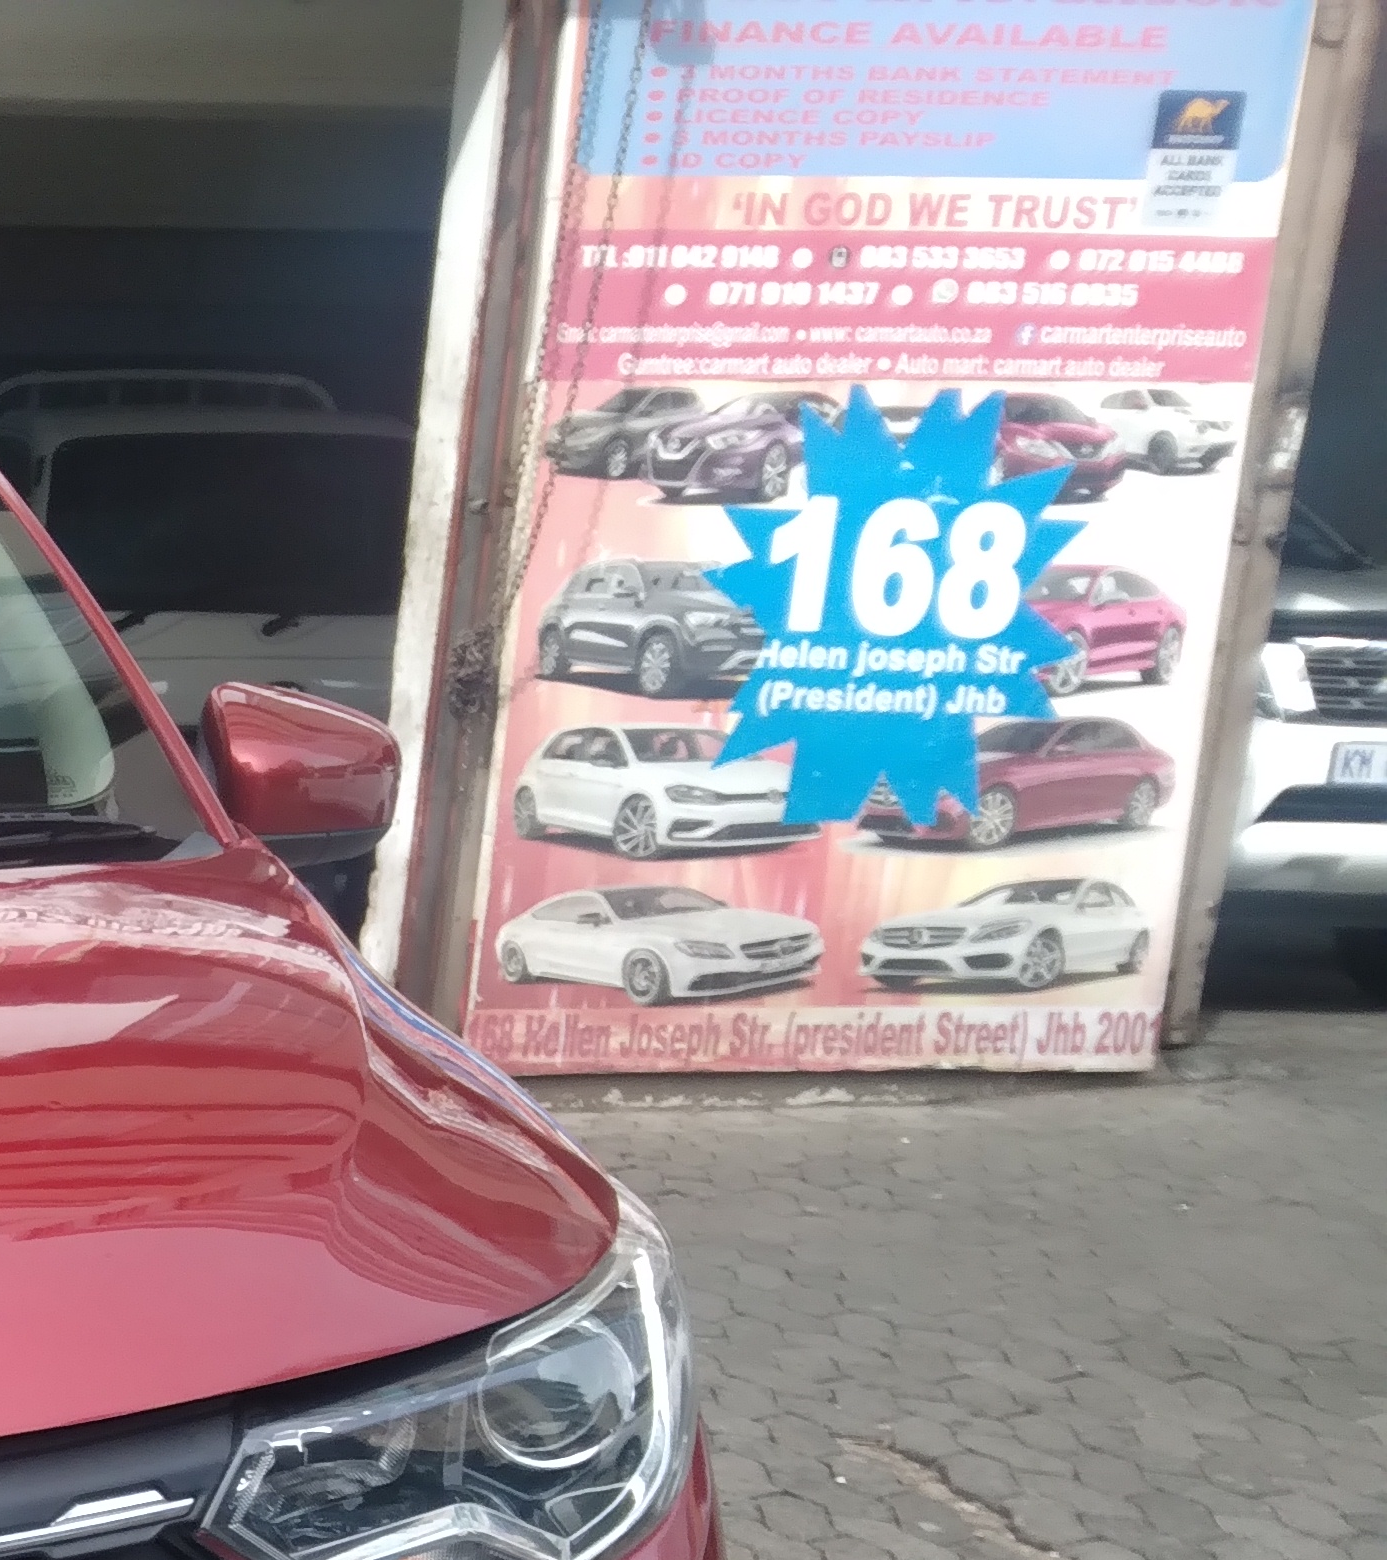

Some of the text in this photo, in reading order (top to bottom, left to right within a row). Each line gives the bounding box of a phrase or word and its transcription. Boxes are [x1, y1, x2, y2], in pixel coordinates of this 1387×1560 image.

[649, 19, 1170, 51] FINANCE AVAILABLE
[708, 64, 854, 83] MONTHS
[867, 65, 961, 85] BANK
[973, 67, 1177, 88] STATEMENT
[676, 88, 1052, 109] PROOF OF RESIDENCE
[673, 107, 927, 128] LICENCE COPY
[701, 130, 849, 148] MONTHS
[858, 131, 997, 149] PAYSLIP
[713, 151, 809, 171] COPY
[802, 193, 893, 230] GOD
[906, 193, 978, 230] WE
[816, 280, 880, 308] 1437
[1039, 324, 1247, 352] carmartenterpriseauto
[815, 353, 873, 376] dealer
[894, 353, 937, 377] Auto
[992, 354, 1061, 377] carmart
[1064, 356, 1105, 378] auto
[1108, 356, 1166, 380] dealer
[769, 495, 1028, 639] 168
[755, 638, 1027, 678] Helen joseph Str
[758, 680, 1008, 721] (President) Jhb
[618, 1011, 722, 1060] Joseph
[727, 1012, 777, 1058] Str.
[783, 1011, 926, 1064] (president
[1036, 1011, 1087, 1056] Jhb
